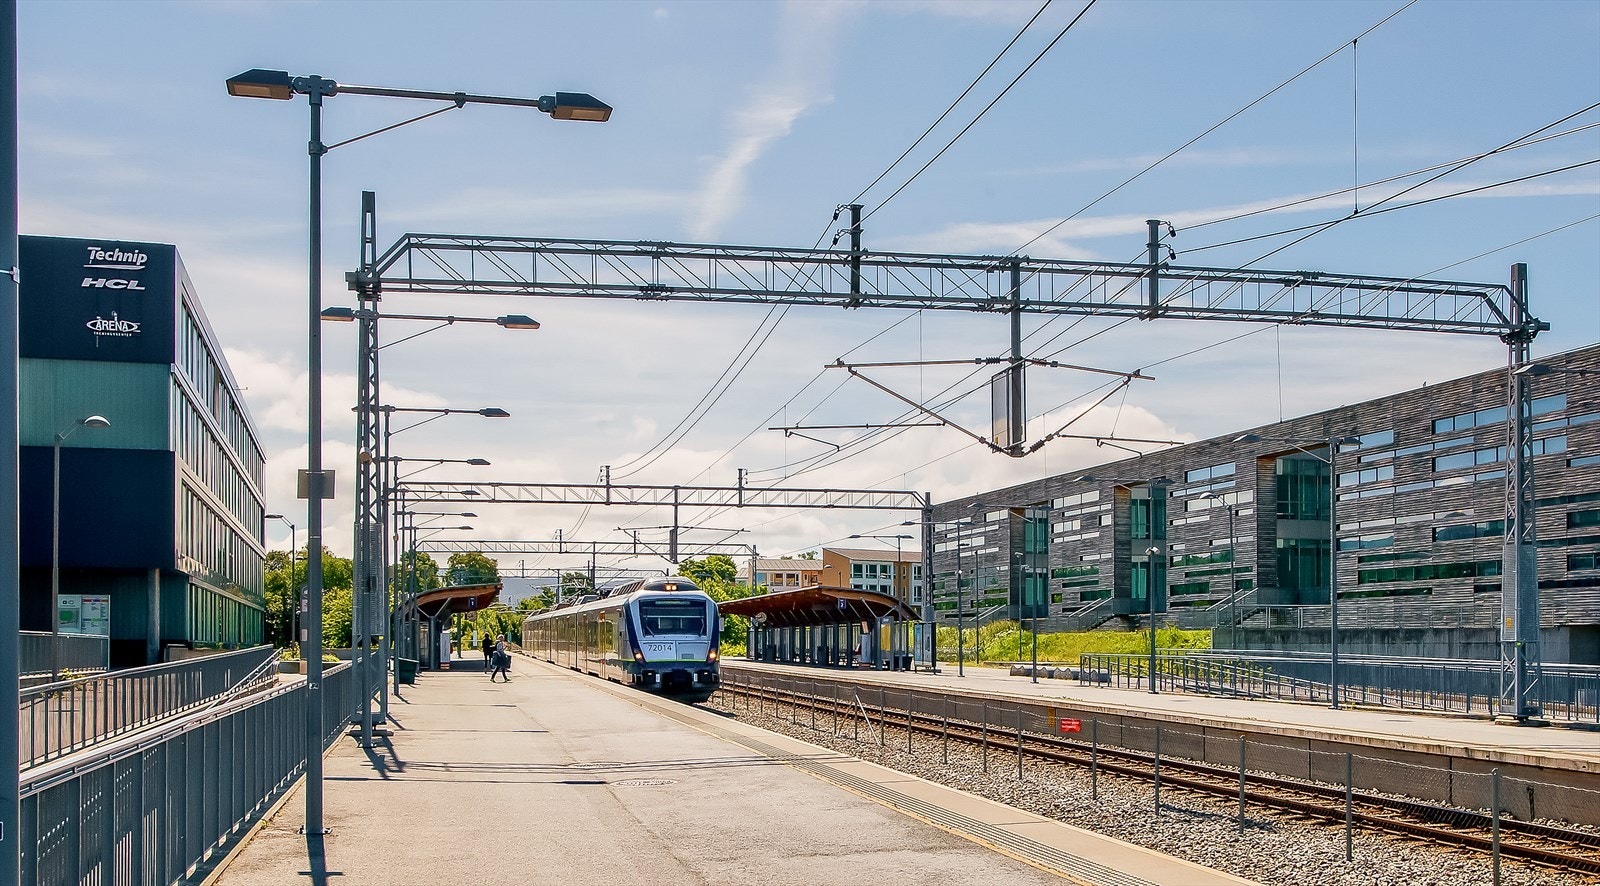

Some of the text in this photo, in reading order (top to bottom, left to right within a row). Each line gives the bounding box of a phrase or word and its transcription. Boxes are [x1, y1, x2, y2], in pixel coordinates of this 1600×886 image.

[87, 246, 148, 266] Technip
[81, 277, 146, 291] HCL
[96, 320, 129, 331] ARENA
[648, 644, 672, 652] 72014
